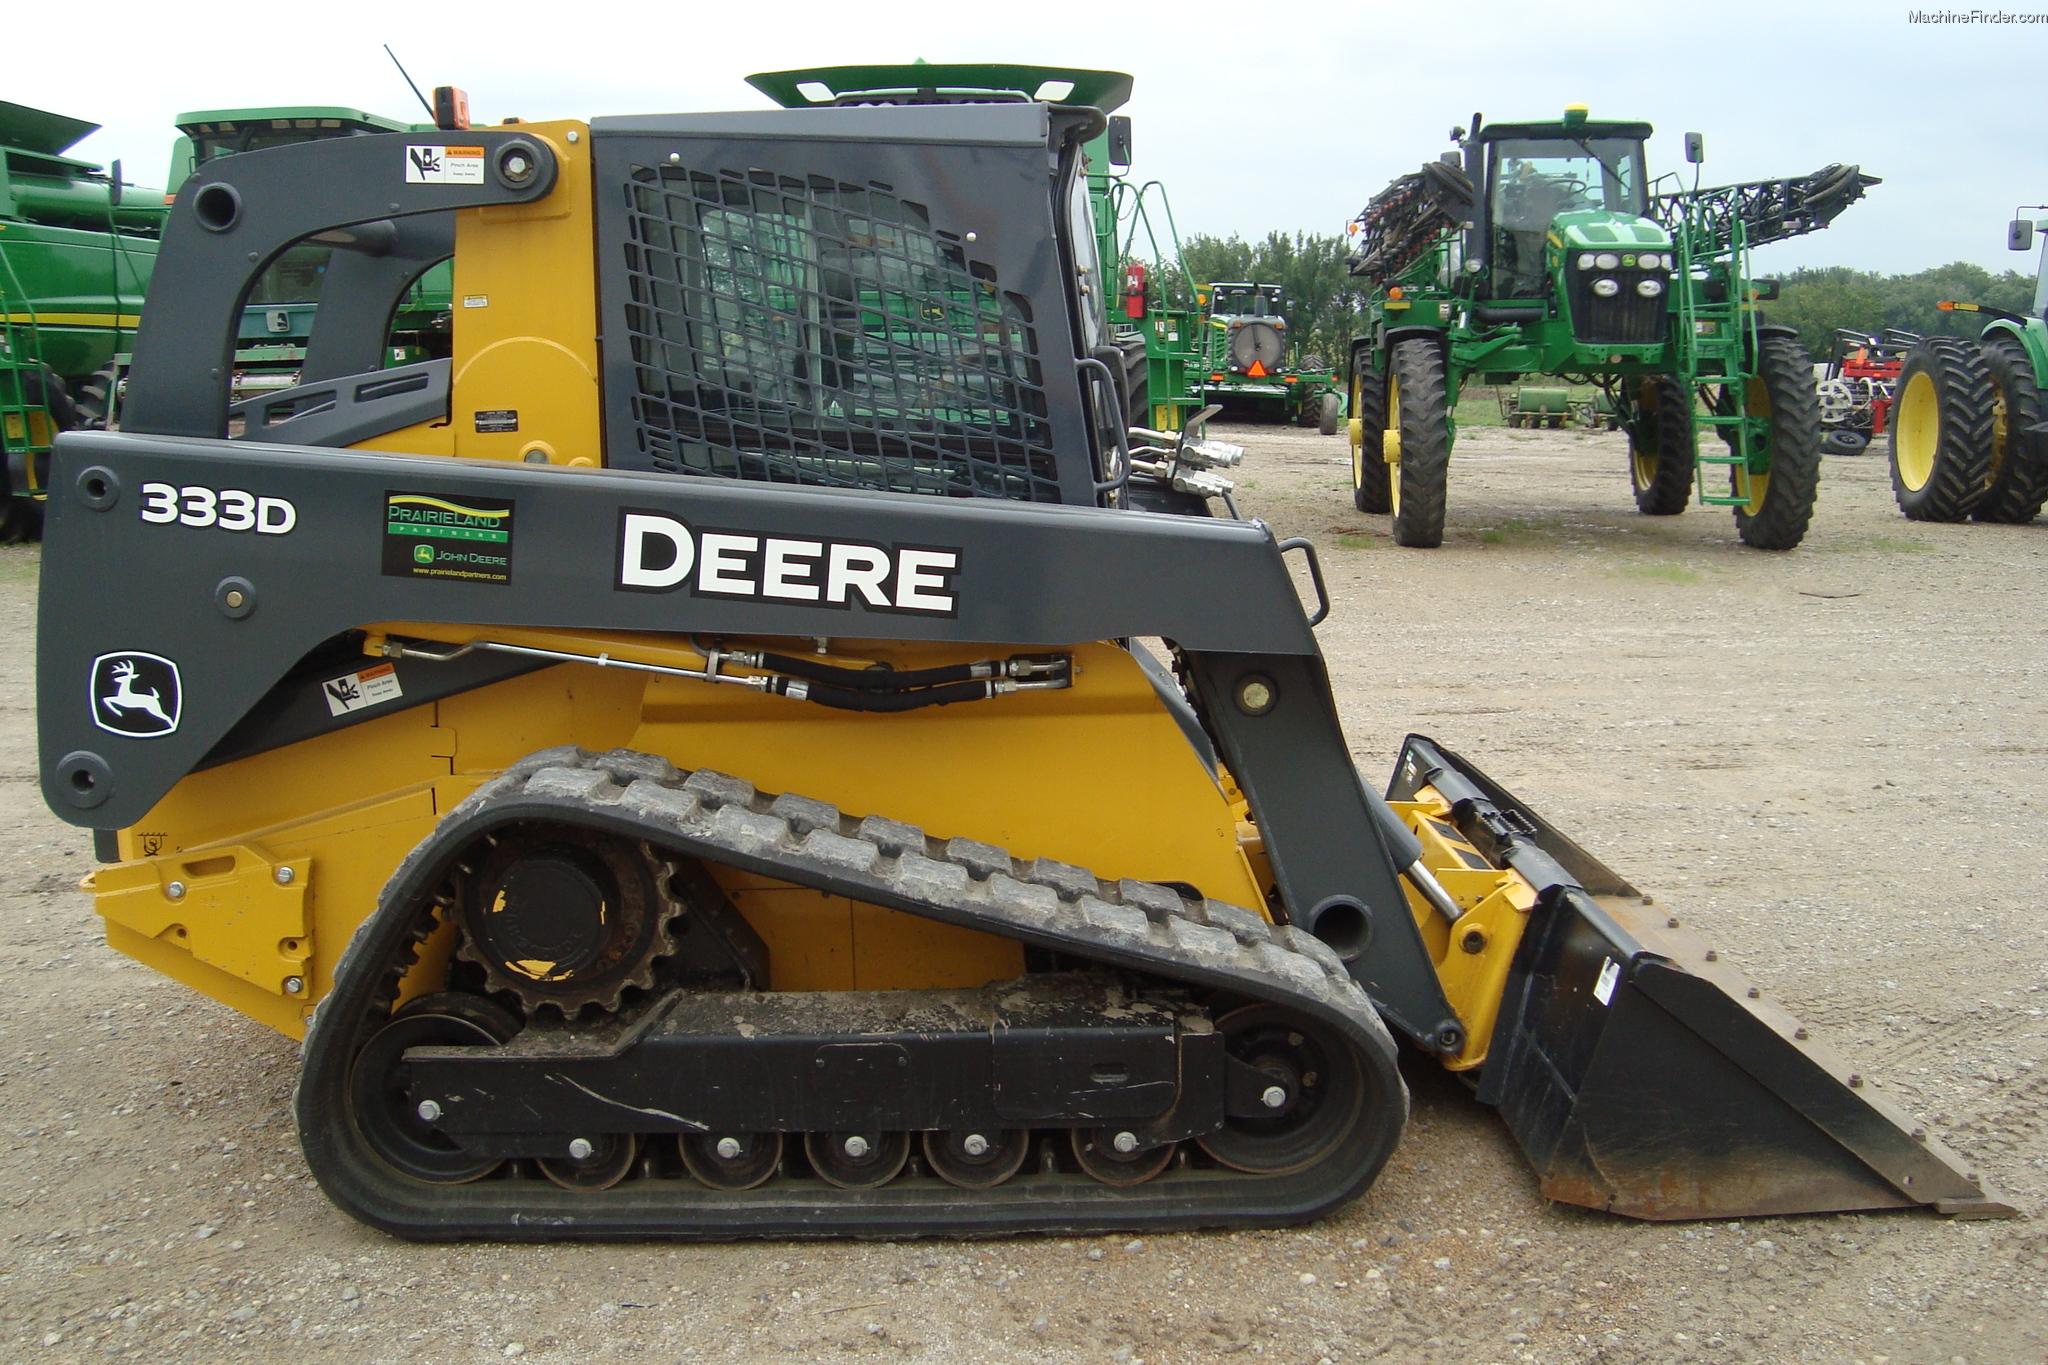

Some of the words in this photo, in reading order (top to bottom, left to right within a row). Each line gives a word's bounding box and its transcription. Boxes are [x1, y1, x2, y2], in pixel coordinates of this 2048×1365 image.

[141, 482, 297, 534] 333D
[400, 526, 497, 539] PARTNERS
[436, 550, 468, 562] JOHN
[469, 553, 508, 566] DEERE
[621, 513, 957, 612] DEERE
[413, 567, 507, 580] www.prairielandpartners.com
